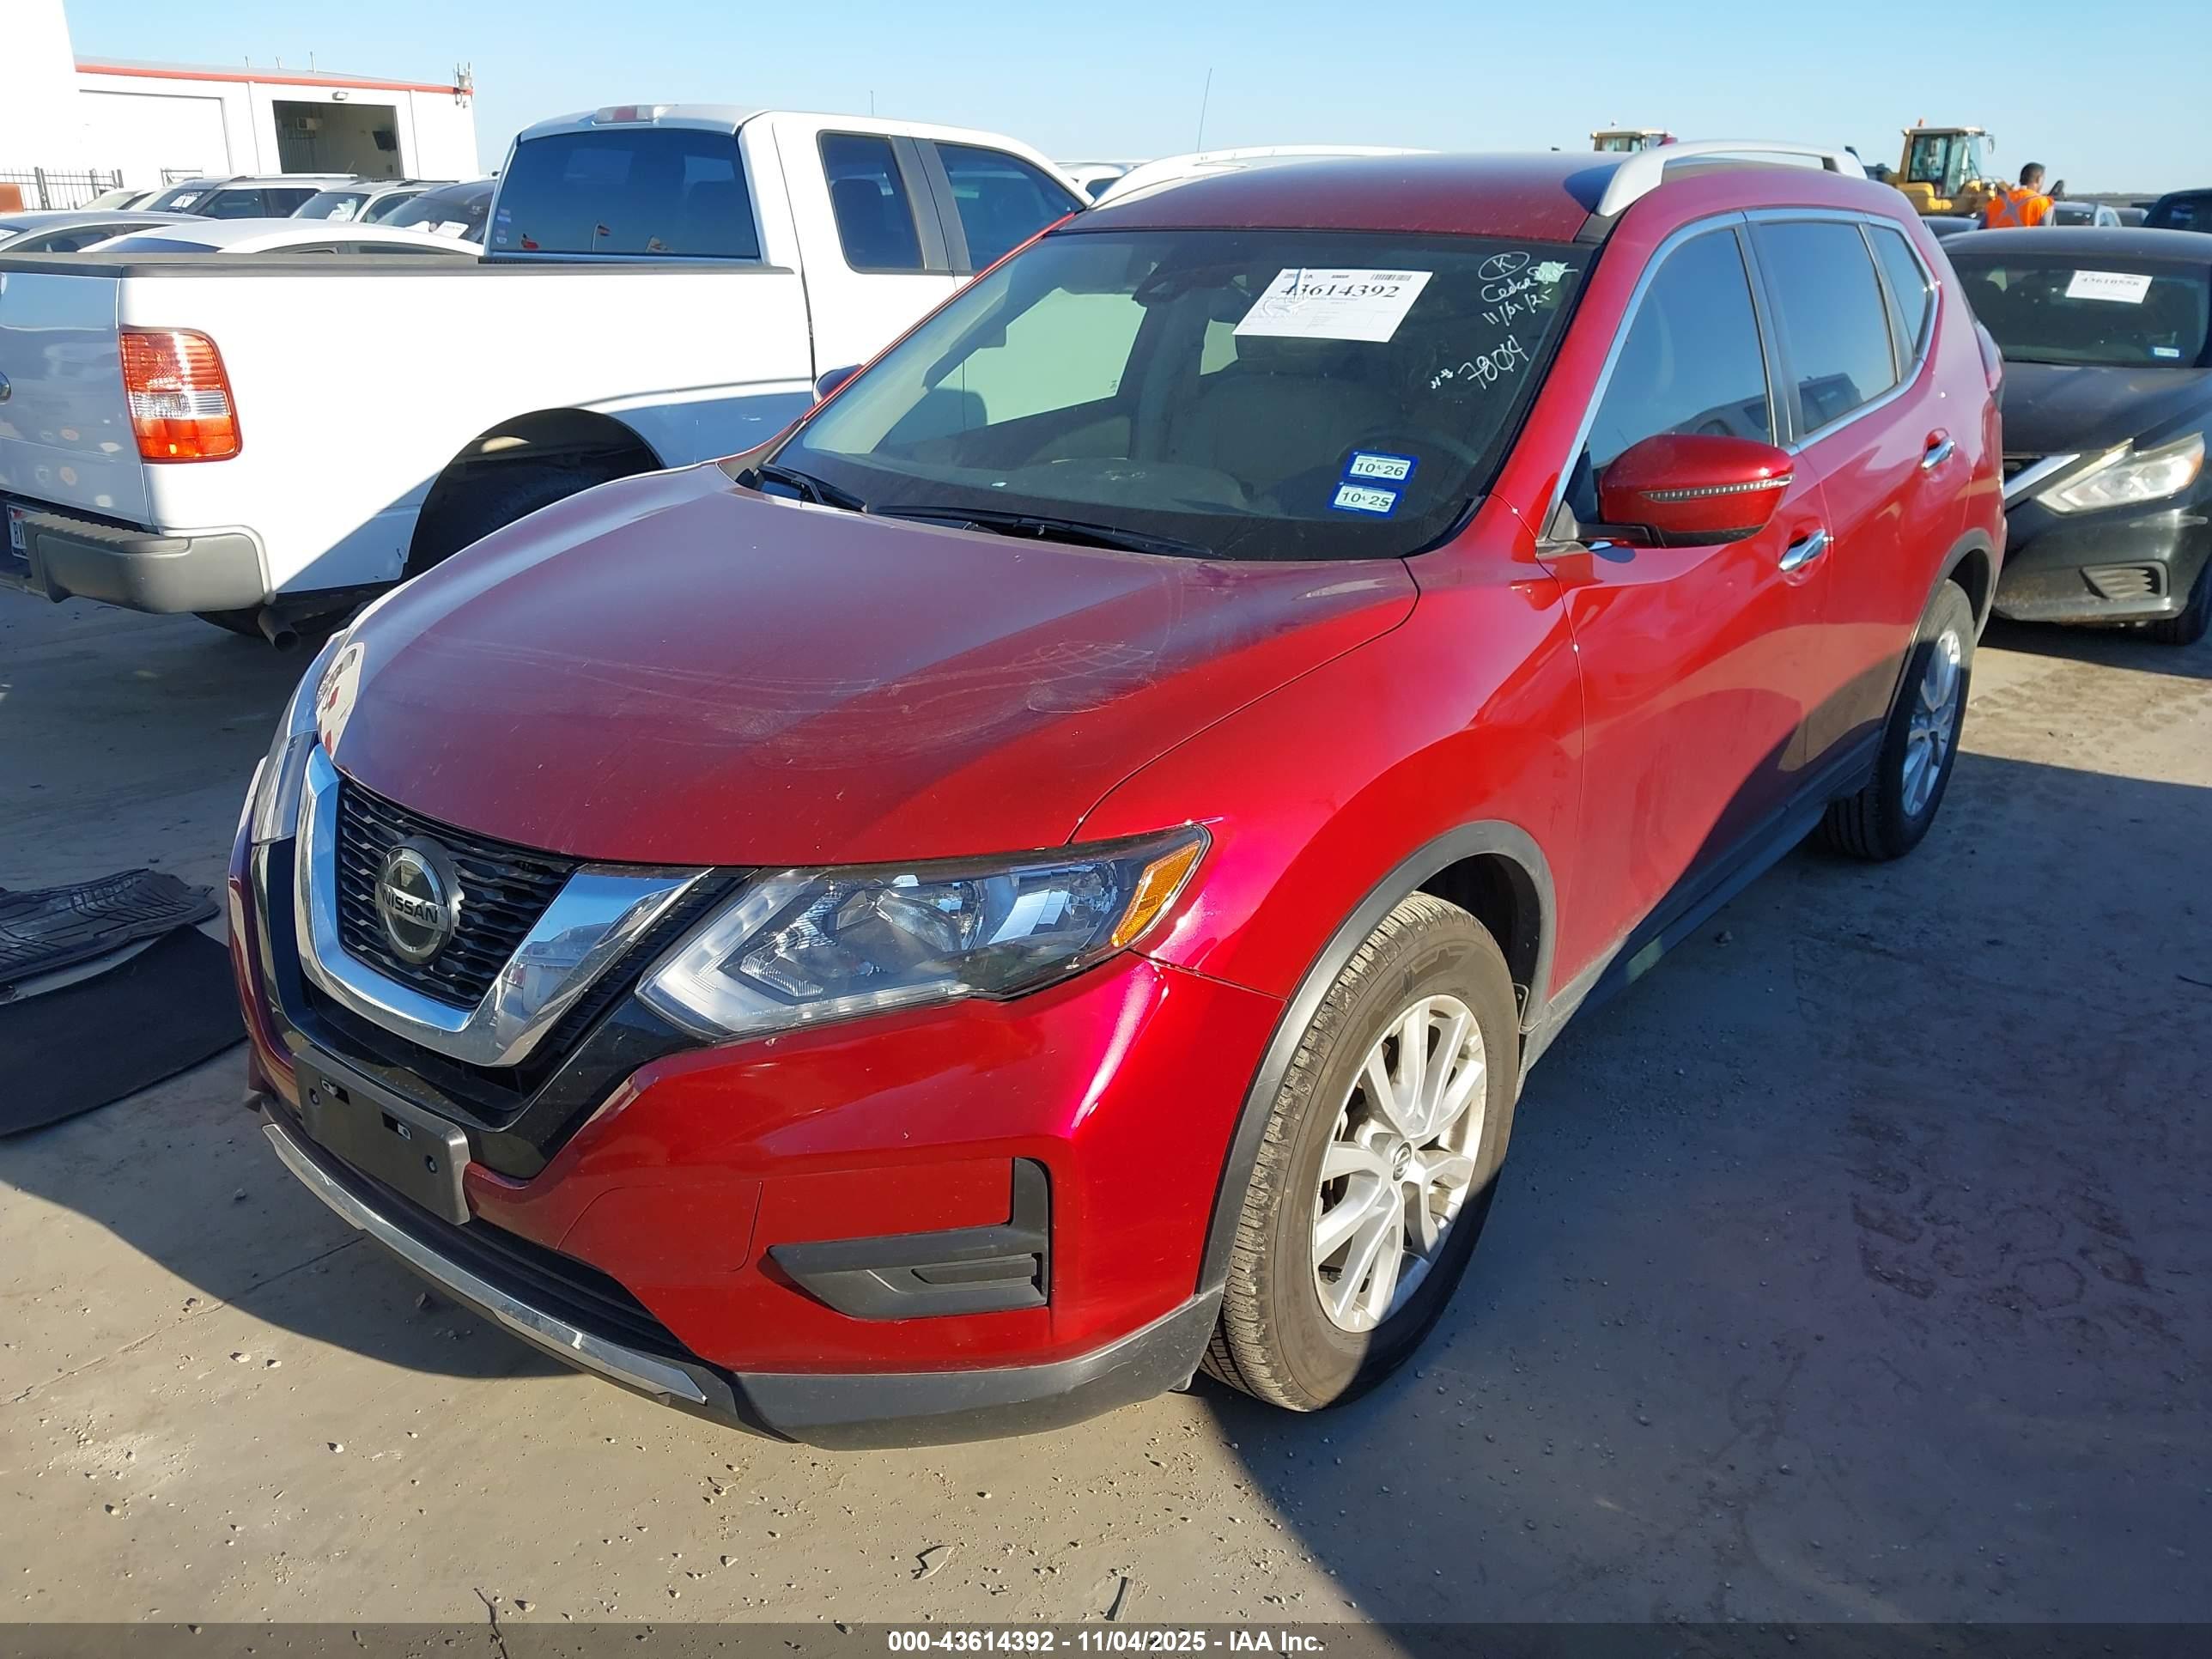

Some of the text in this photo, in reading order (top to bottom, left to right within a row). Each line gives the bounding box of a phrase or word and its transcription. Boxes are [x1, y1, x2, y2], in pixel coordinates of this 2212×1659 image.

[1280, 283, 1401, 298] 43614392
[1357, 462, 1376, 473] 10
[1382, 465, 1405, 477] 26
[1342, 492, 1391, 507] 10 25
[382, 888, 439, 924] NISSAN
